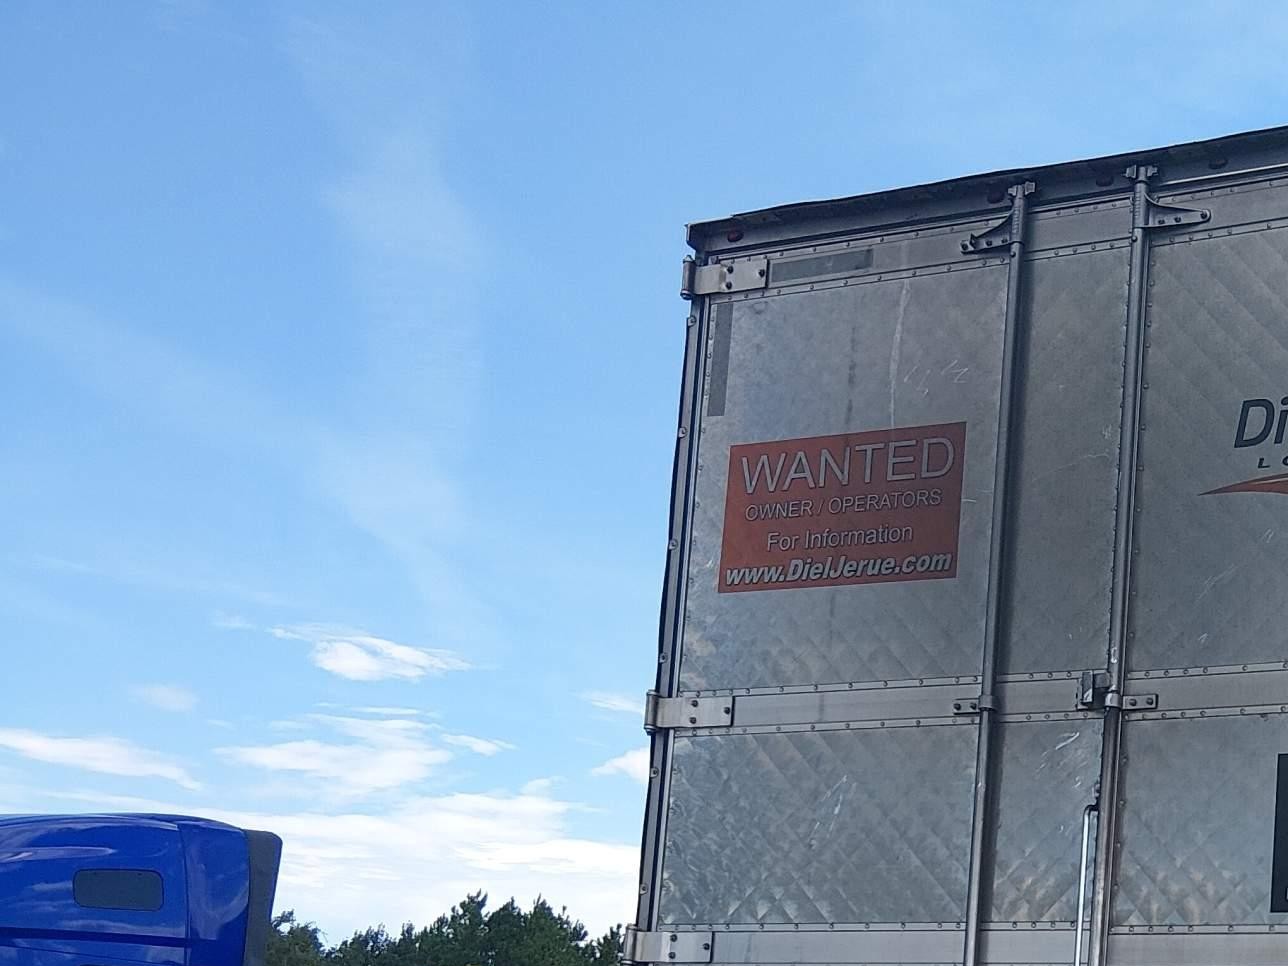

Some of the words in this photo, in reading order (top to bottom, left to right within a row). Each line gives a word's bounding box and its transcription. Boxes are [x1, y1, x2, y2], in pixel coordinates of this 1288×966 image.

[740, 437, 955, 495] WANTED
[744, 500, 813, 521] OWNER
[828, 488, 942, 514] OPERATORS
[767, 531, 799, 551] For
[804, 525, 913, 549] Information
[725, 552, 952, 586] www.DielJerue.com
